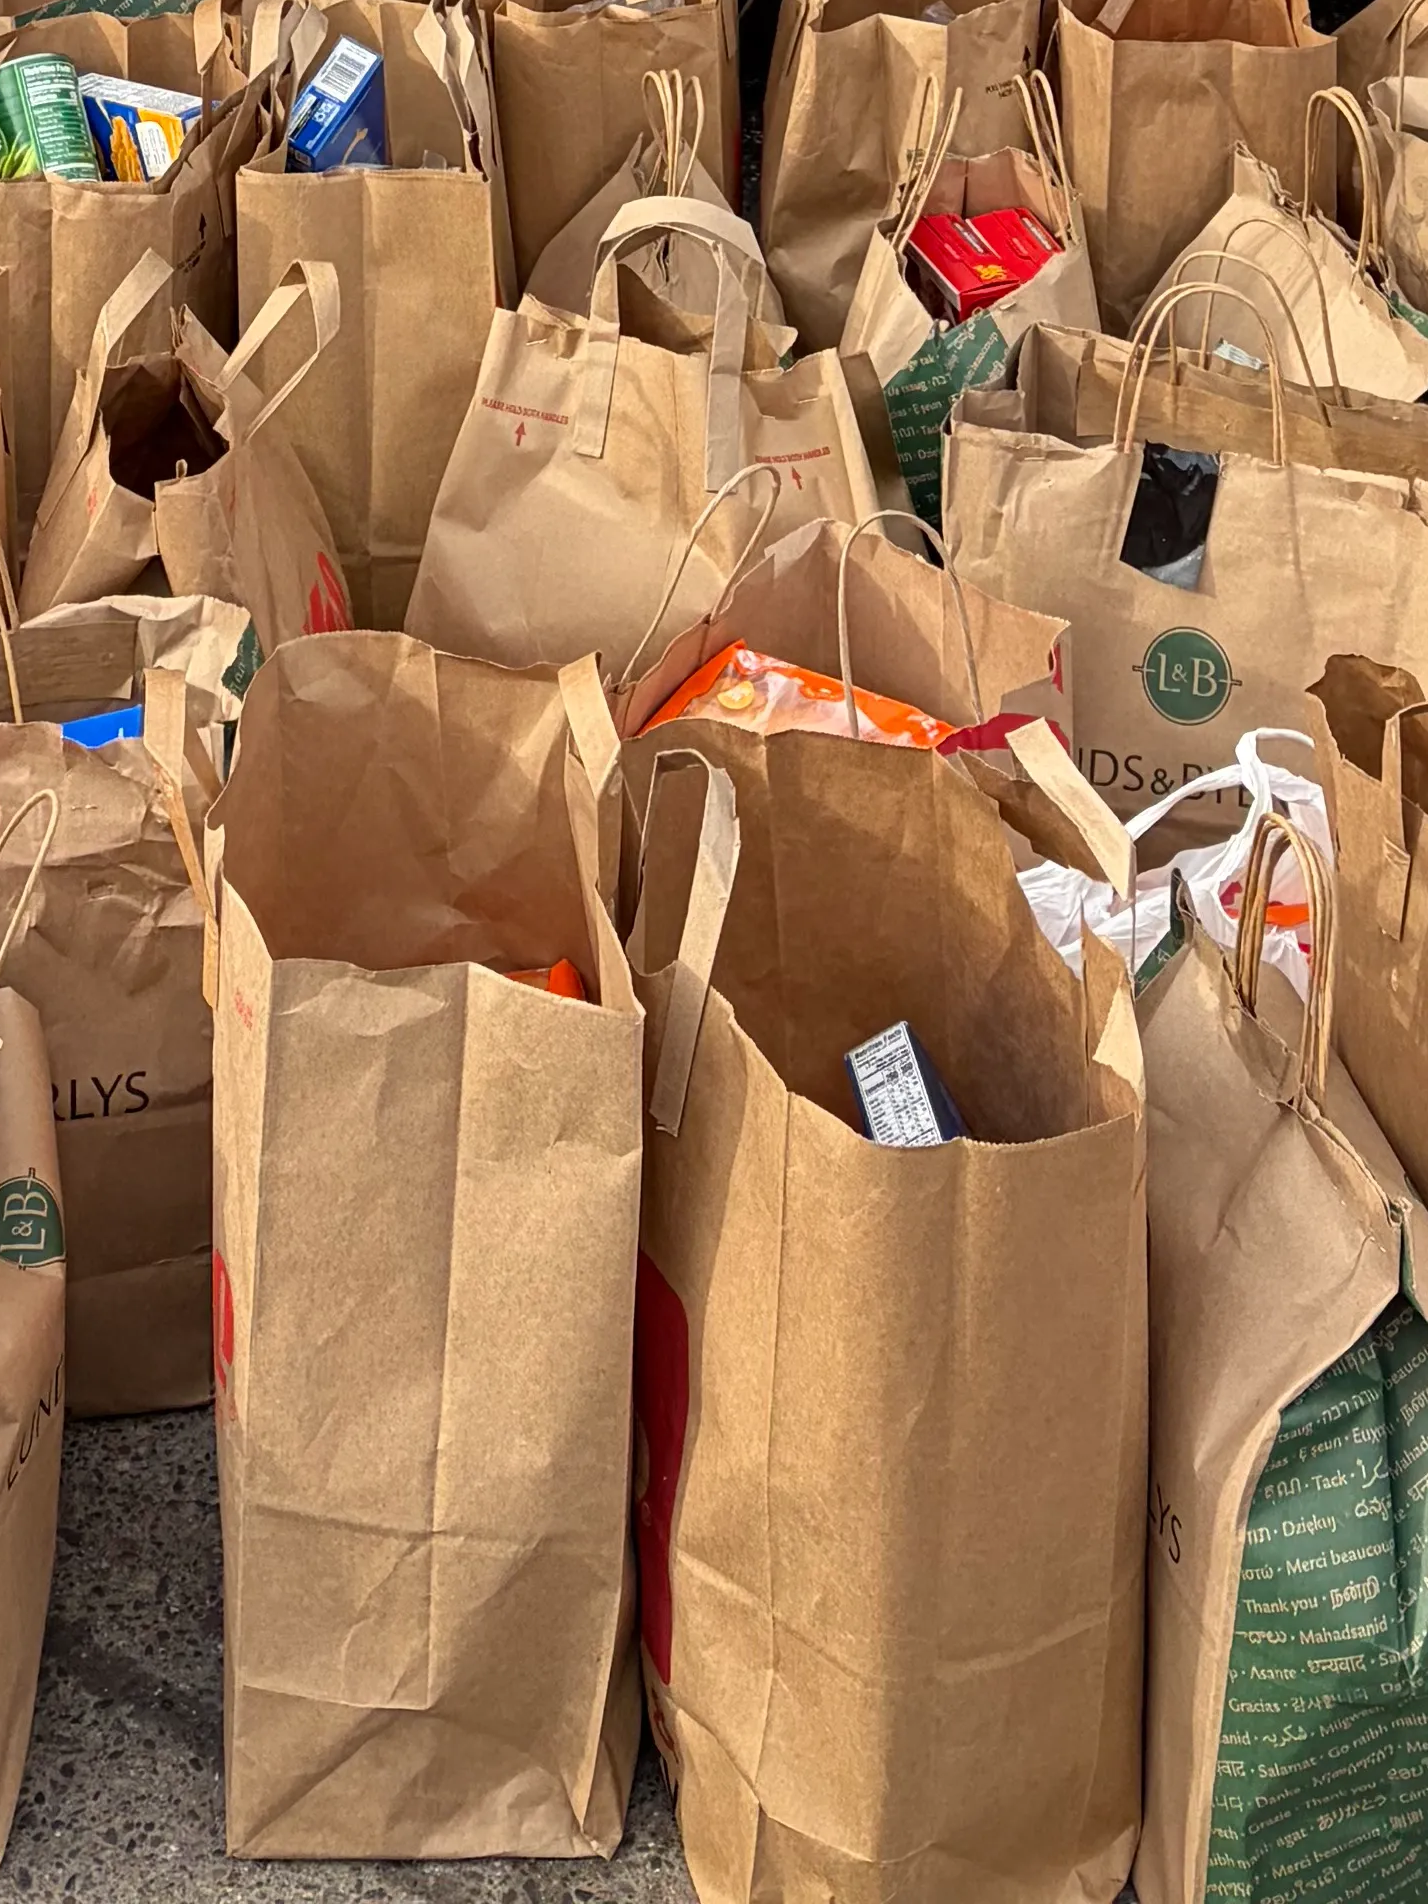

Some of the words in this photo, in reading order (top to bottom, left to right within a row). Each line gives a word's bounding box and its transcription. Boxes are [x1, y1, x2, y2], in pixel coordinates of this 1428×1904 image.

[1157, 652, 1218, 697] L&B
[0, 1191, 50, 1252] L&B
[1312, 1470, 1348, 1492] Tack
[1285, 1555, 1327, 1576] Merci
[1243, 1599, 1290, 1616] Thank
[1291, 1597, 1319, 1613] you
[1299, 1616, 1388, 1644] Mahadsanid
